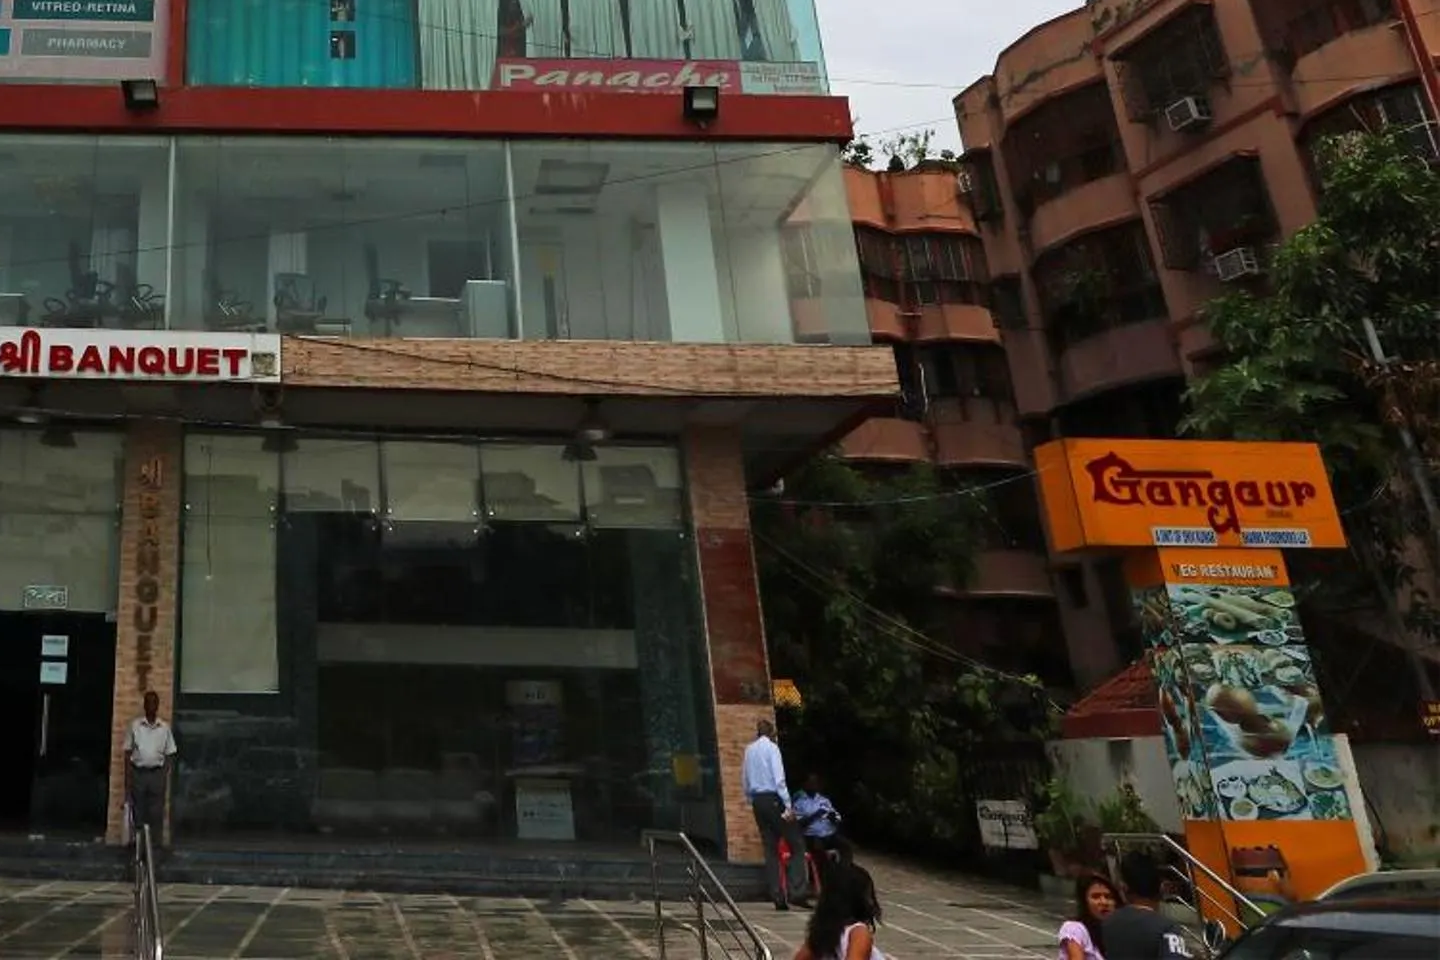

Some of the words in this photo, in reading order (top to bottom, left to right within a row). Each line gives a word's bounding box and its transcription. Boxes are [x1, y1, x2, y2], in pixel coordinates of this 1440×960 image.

[46, 38, 127, 50] PHARMACY
[499, 62, 731, 88] Panache
[48, 344, 248, 377] BANQUET
[1085, 451, 1317, 535] Gangaur
[1171, 563, 1197, 578] VEG
